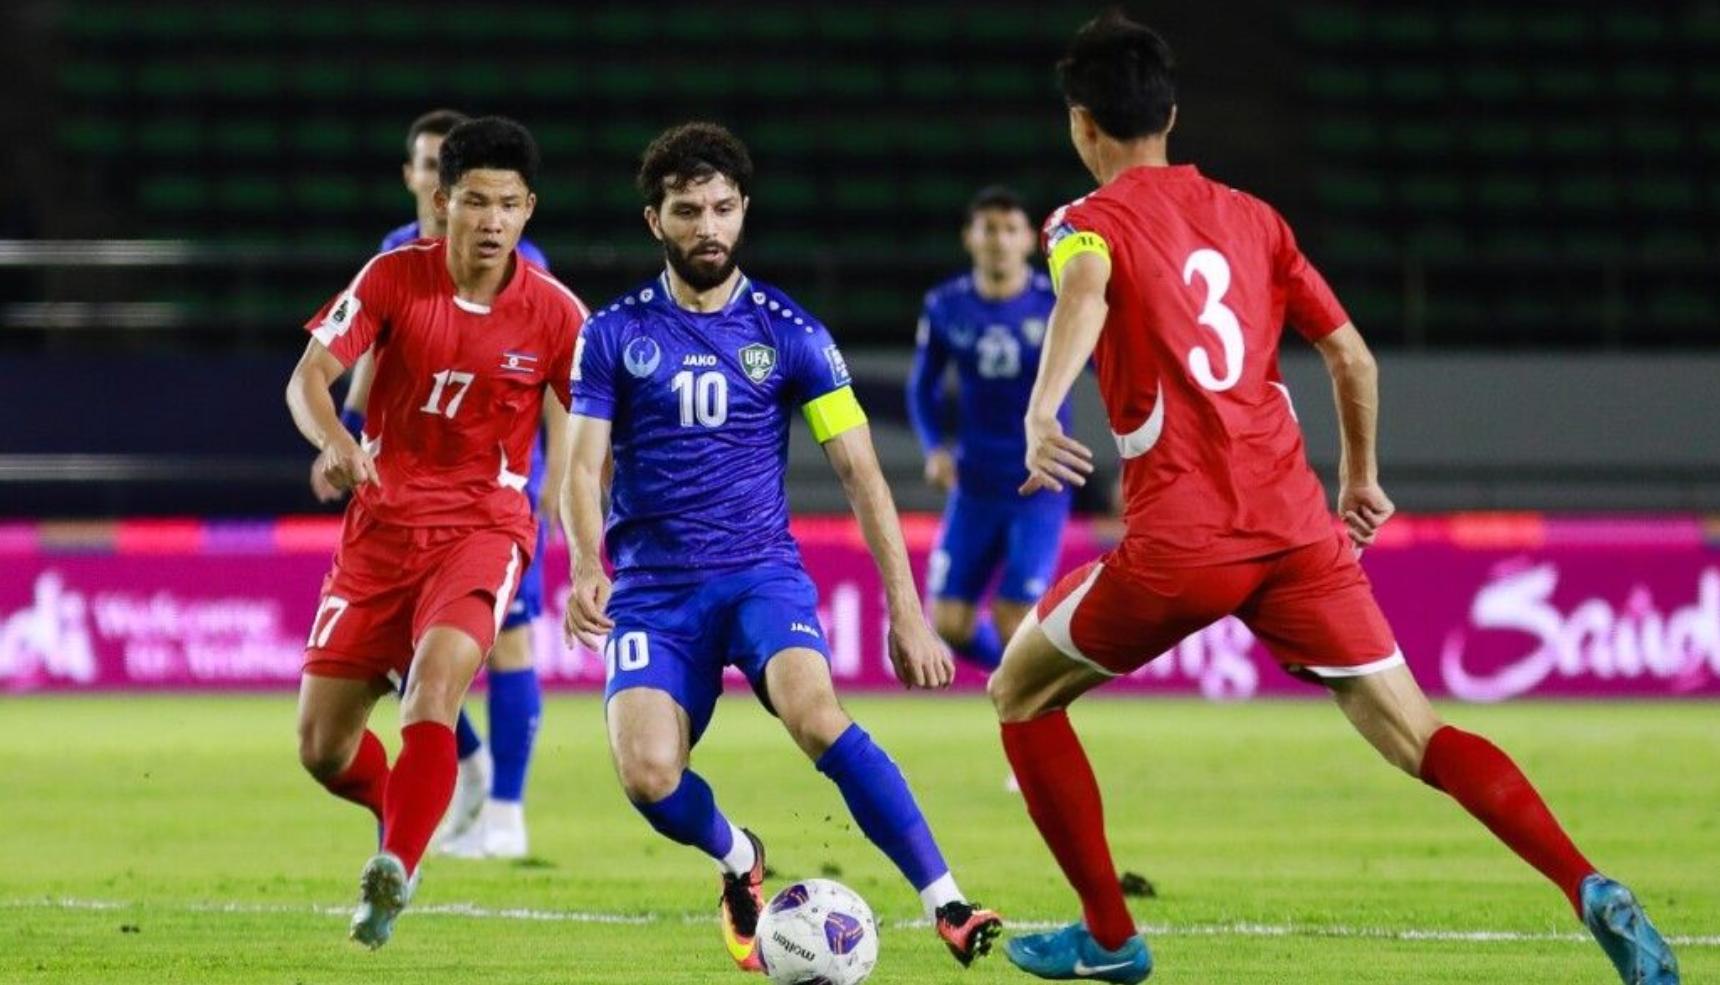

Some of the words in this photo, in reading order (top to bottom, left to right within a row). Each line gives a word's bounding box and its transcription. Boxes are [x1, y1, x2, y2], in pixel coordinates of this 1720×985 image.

[1183, 249, 1245, 391] 3
[683, 354, 717, 366] JAKO
[745, 350, 770, 365] UFA
[420, 369, 475, 419] 17
[671, 371, 727, 428] 10
[773, 931, 816, 961] molten
